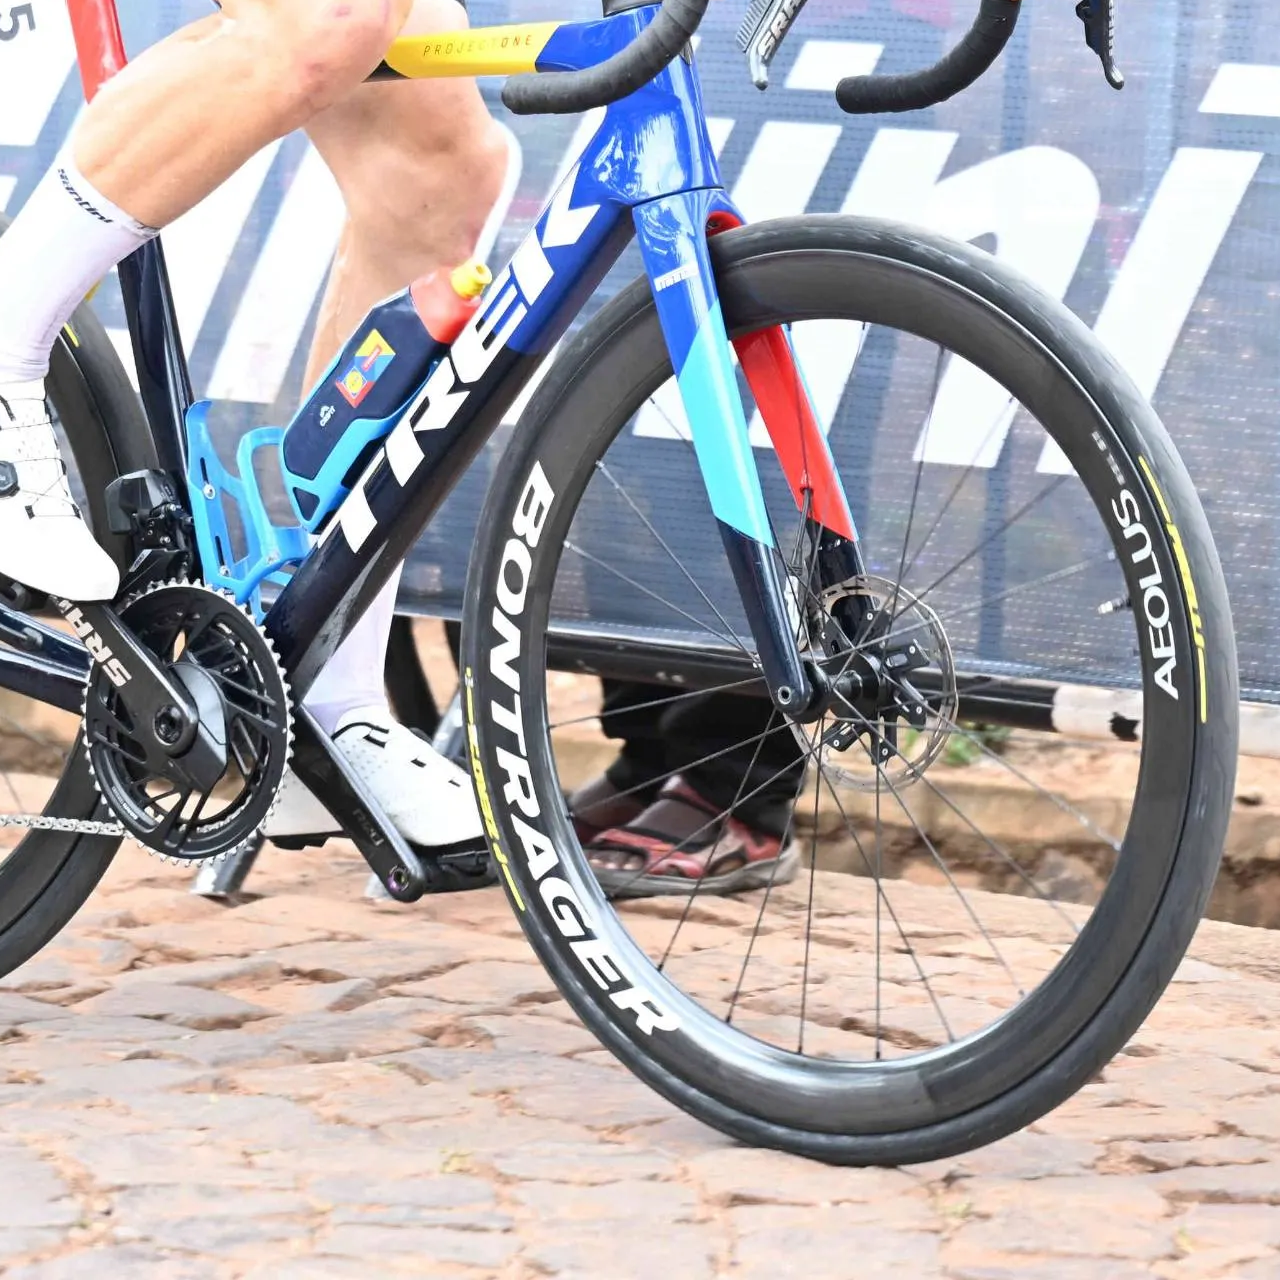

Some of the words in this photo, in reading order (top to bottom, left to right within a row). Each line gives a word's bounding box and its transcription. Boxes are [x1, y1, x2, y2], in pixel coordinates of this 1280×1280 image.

[317, 160, 602, 554] TREK
[489, 459, 681, 1039] BONTRAGER
[1111, 488, 1180, 701] AEOLUS
